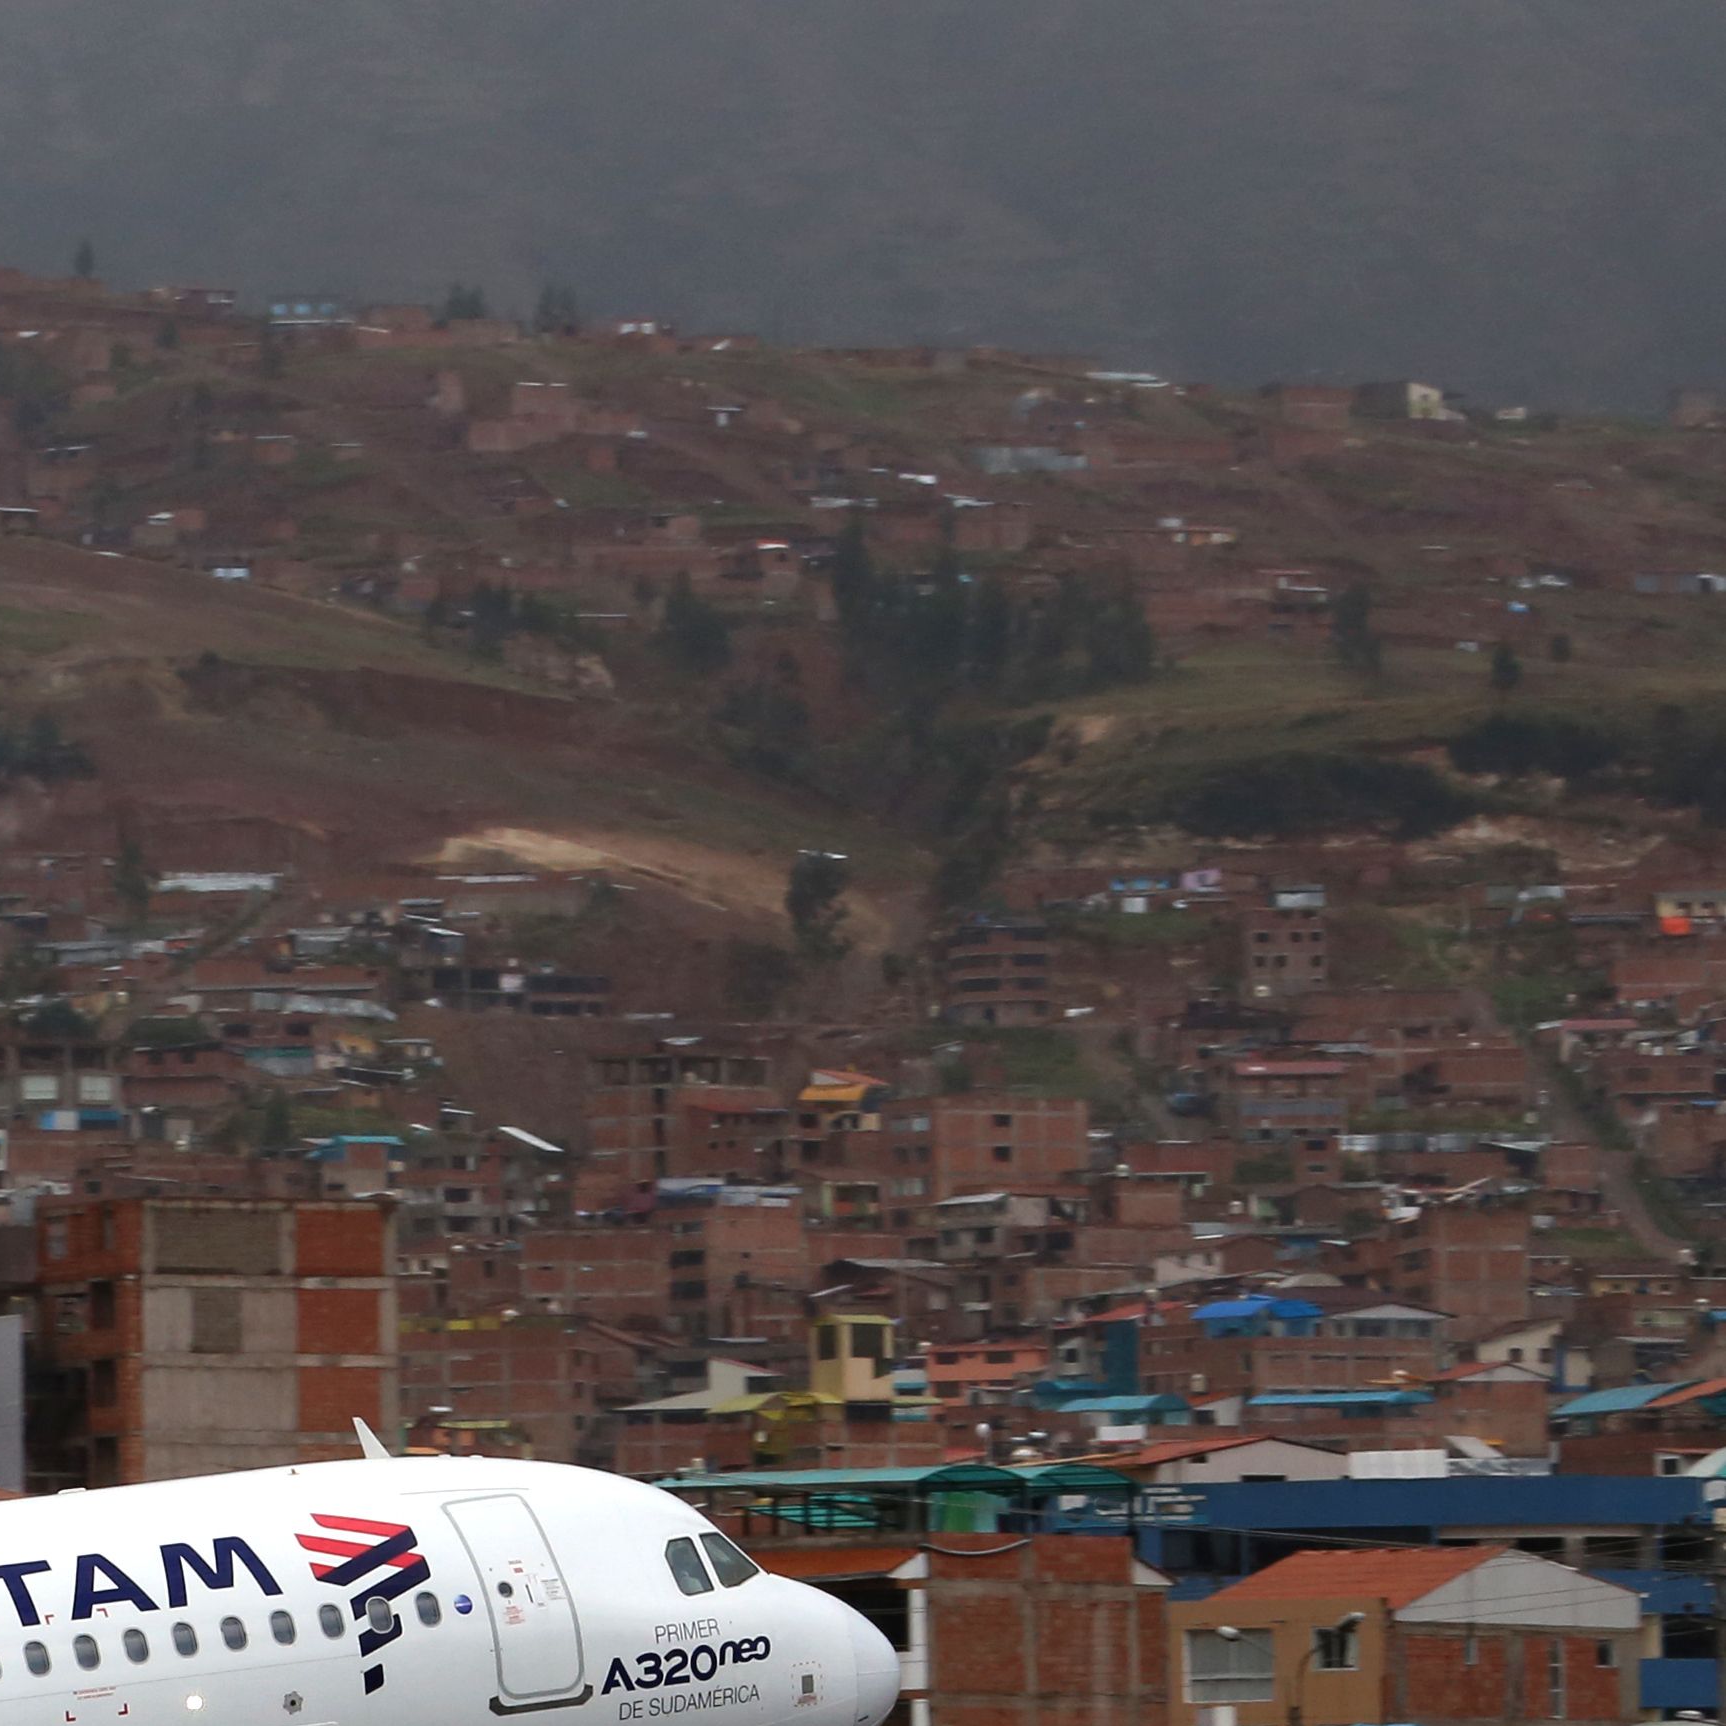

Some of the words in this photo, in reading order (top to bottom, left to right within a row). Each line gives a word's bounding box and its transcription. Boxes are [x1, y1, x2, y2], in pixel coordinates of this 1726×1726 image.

[654, 1618, 721, 1644] PRIMER
[601, 1635, 771, 1695] A320neo
[619, 1700, 644, 1721] DE
[648, 1684, 761, 1717] SUDAMÉRICA
